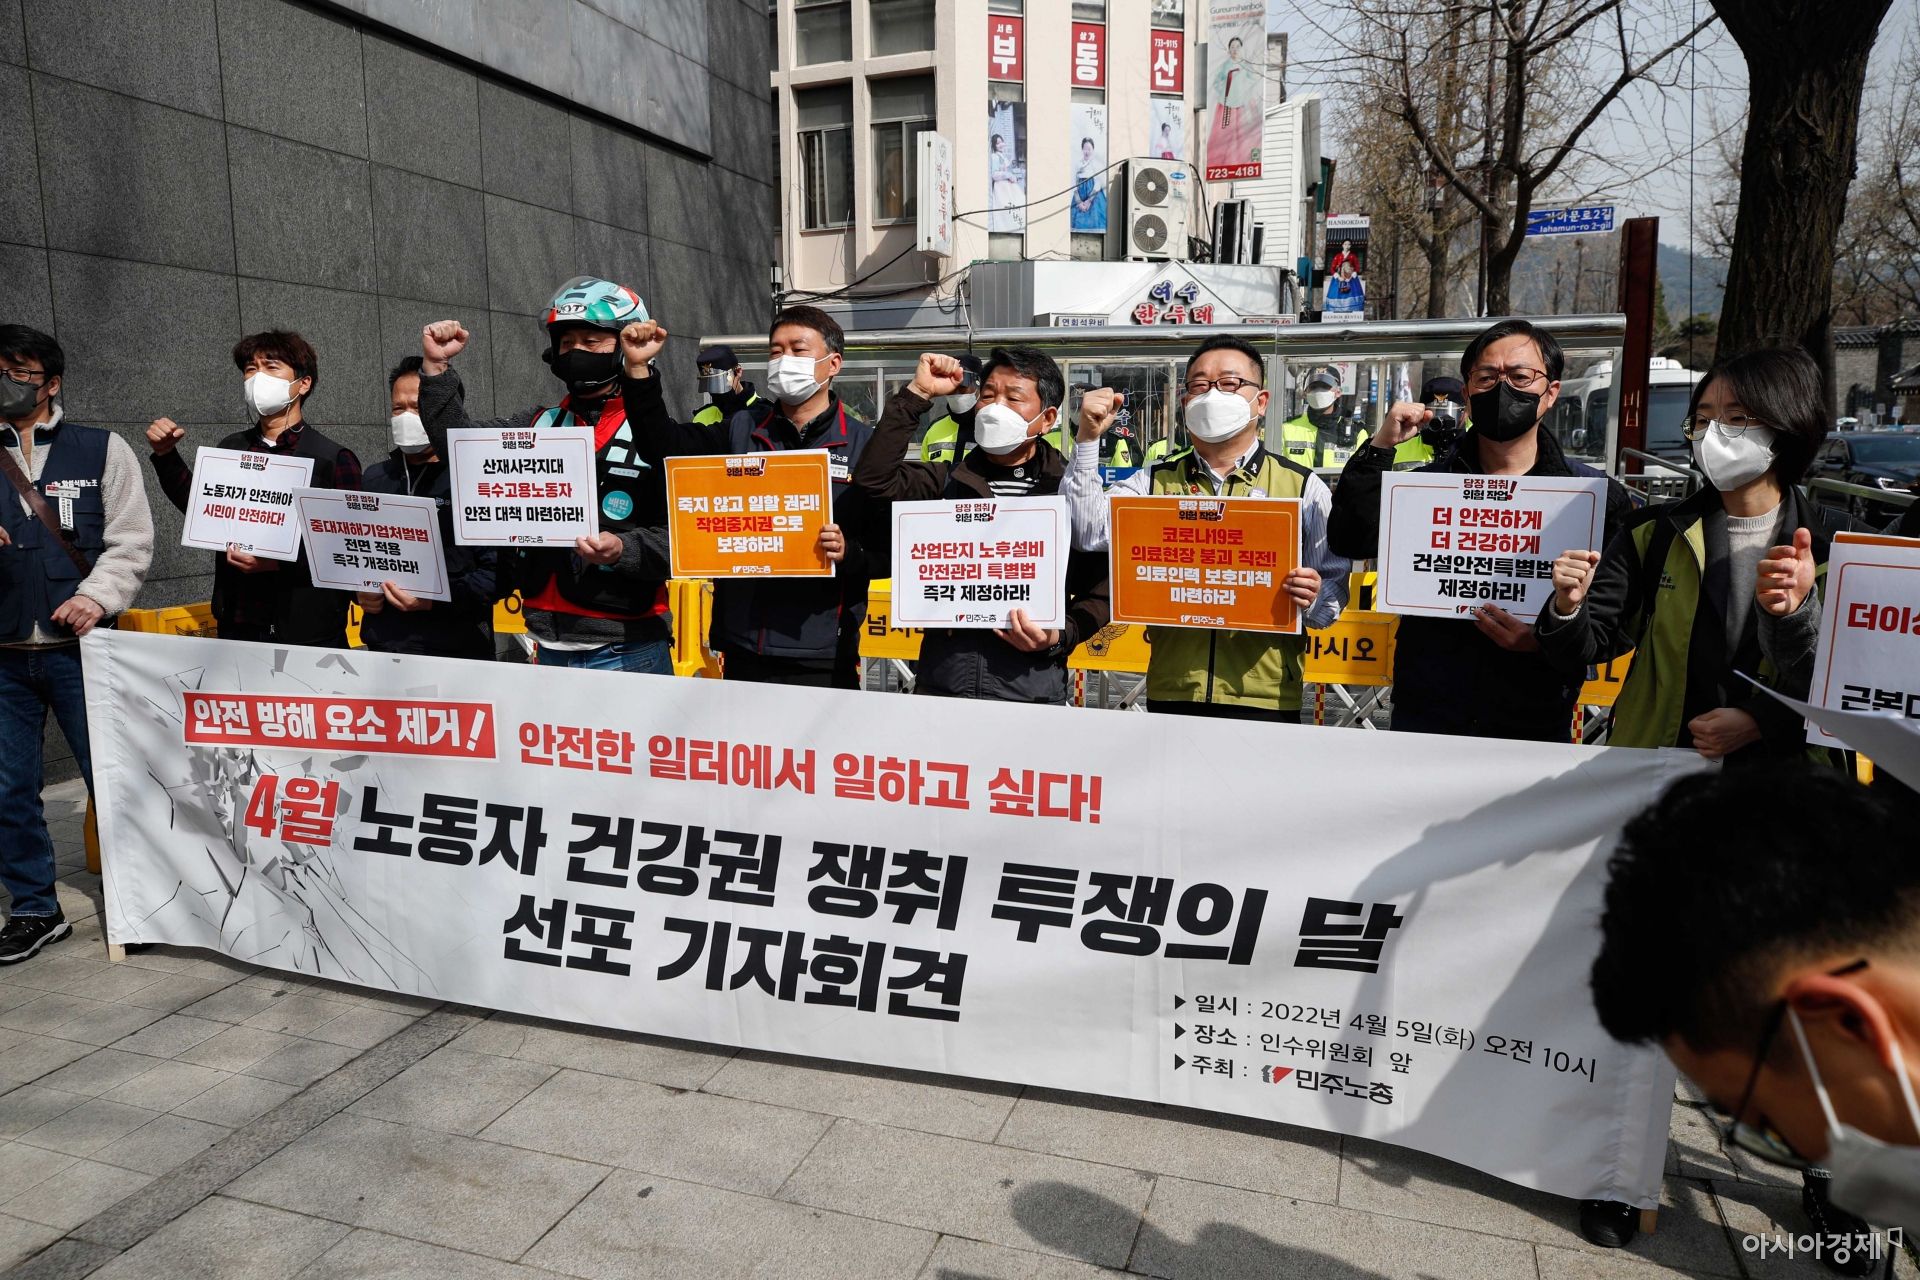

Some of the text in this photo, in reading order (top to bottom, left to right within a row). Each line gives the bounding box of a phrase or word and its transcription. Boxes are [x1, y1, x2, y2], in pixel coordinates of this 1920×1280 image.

[997, 24, 1013, 33] 서촌
[1079, 31, 1096, 41] 상가
[1154, 38, 1178, 48] 733-9115
[1208, 165, 1259, 178] 723-4181
[1328, 218, 1368, 226] HANBOKDAY
[1152, 280, 1200, 302] 여수
[1135, 303, 1214, 325] 한두레
[501, 431, 531, 440] 당장 멈춰
[502, 441, 517, 449] 위험
[253, 455, 265, 463] 멈춰
[483, 458, 564, 474] 산재사각지대
[726, 458, 742, 467] 당장
[726, 468, 743, 476] 위험
[478, 482, 573, 498] 특수고용노동자
[1463, 478, 1509, 490] 당장 멈춰
[203, 483, 293, 506] 노동자가 안전해야
[345, 494, 374, 503] 당장 멈춰
[1463, 490, 1484, 500] 위험
[346, 502, 361, 510] 위험
[678, 494, 820, 513] 죽지 않고 일할 권리!
[955, 503, 990, 512] 당장 멈춰
[1178, 500, 1218, 511] 당장 멈춰
[203, 504, 286, 526] 시민이 안전하다!
[465, 506, 584, 522] 안전 대책 마련하라!
[955, 513, 972, 522] 위험
[1178, 511, 1198, 521] 위험
[1432, 507, 1543, 530] 더 안전하게
[310, 519, 429, 543] 중대재해기업처벌법
[696, 516, 804, 532] 작업중지권으로
[517, 535, 543, 543] 민주노총
[717, 536, 784, 553] 보장하라!
[1162, 527, 1244, 546] 코로나19로
[1431, 531, 1541, 554] 더 건강하게
[344, 538, 401, 556] 전면 적용
[911, 540, 1044, 560] 산업단지 노후설비
[332, 553, 420, 574] 즉각 개정하라!
[1131, 546, 1277, 567] 의료현장 붕괴 직전!
[742, 566, 771, 574] 민주노총
[918, 563, 1036, 580] 안전관리 특별법
[1413, 553, 1554, 580] 건설안전특별법
[1136, 566, 1272, 588] 의료인력 보호대책
[923, 584, 1030, 602] 즉각 제정하라!
[1170, 587, 1236, 606] 마련하라
[1437, 579, 1526, 602] 제정하라!
[966, 614, 997, 622] 민주노총
[1192, 615, 1225, 625] 민주노총
[193, 699, 486, 752] 안전 방해 요소 제거!
[519, 722, 1103, 824] 안전한 일터에서 일하고 싶다!
[243, 773, 1404, 974] 4월 노동자 건강권 쟁취 투쟁의 달
[503, 894, 968, 1023] 선포 기자회견
[1195, 995, 1238, 1016] 일시
[1260, 1001, 1341, 1029] 2022년
[1349, 1014, 1387, 1036] 4월
[1396, 1020, 1475, 1051] 5일(화)
[1483, 1035, 1533, 1064] 오전
[1543, 1047, 1596, 1083] 10시
[1194, 1024, 1238, 1046] 장소
[1260, 1033, 1373, 1067] 인수위원회
[1389, 1052, 1413, 1074] 앞
[1191, 1055, 1234, 1078] 주최
[1295, 1069, 1394, 1105] 민주노총
